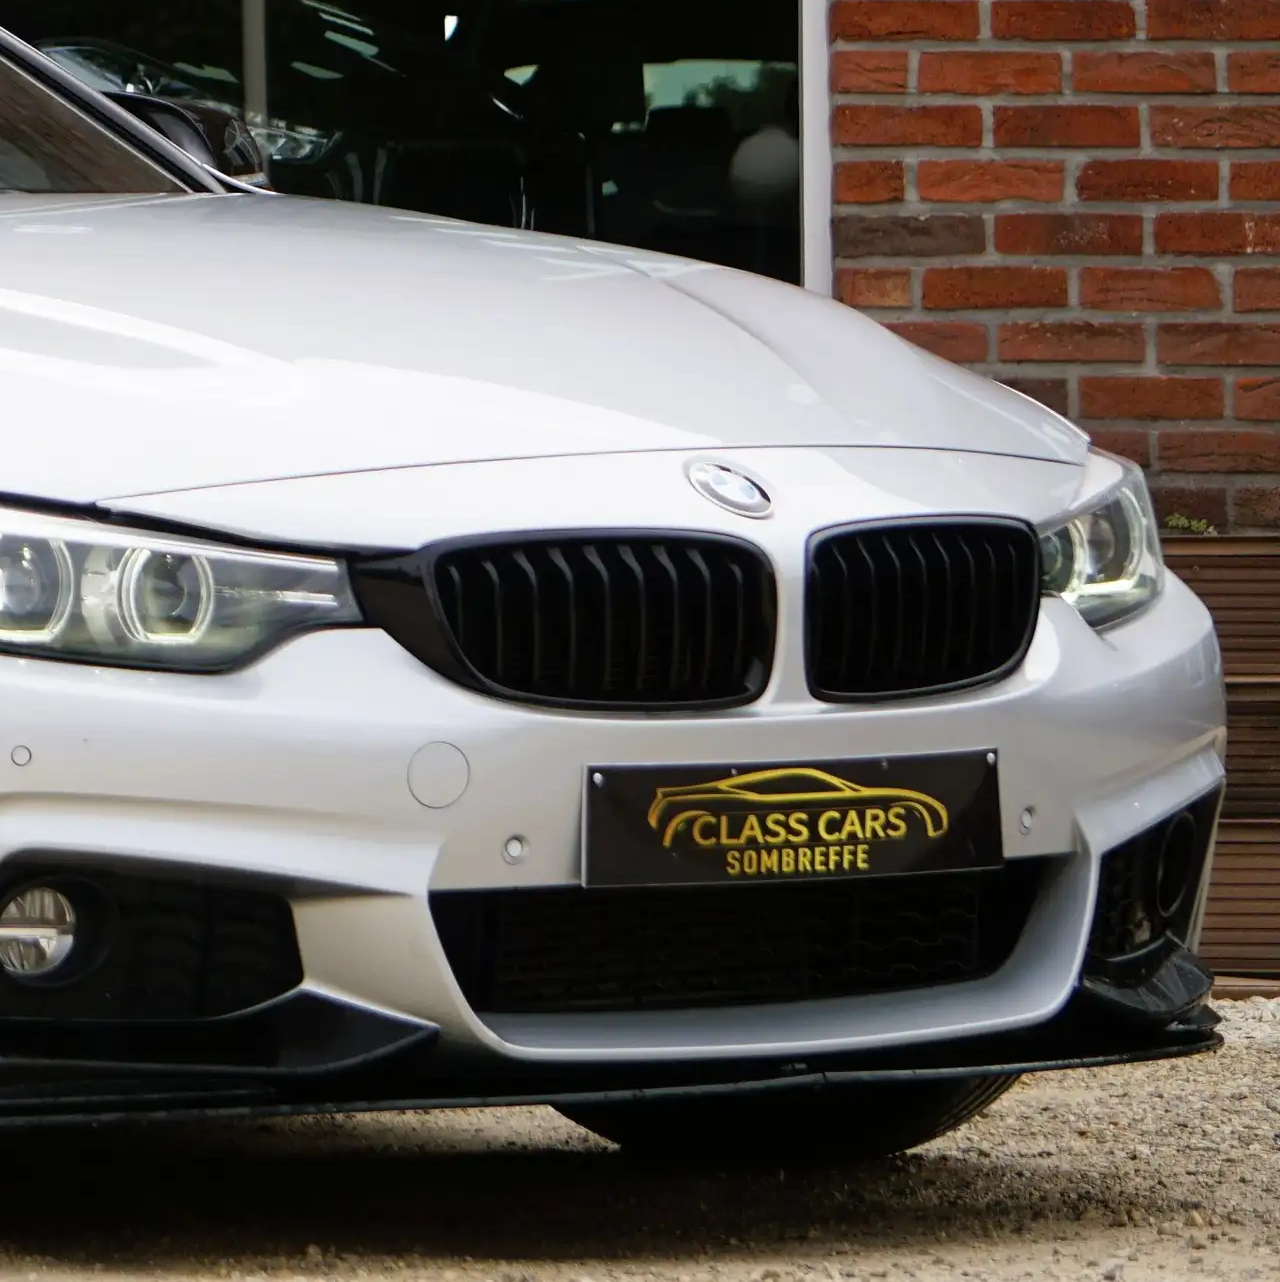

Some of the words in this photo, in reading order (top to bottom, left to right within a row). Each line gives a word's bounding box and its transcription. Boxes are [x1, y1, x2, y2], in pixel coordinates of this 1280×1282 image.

[692, 812, 810, 845] CLASS
[817, 806, 907, 842] CARS
[726, 844, 870, 875] SOMBREFFE
